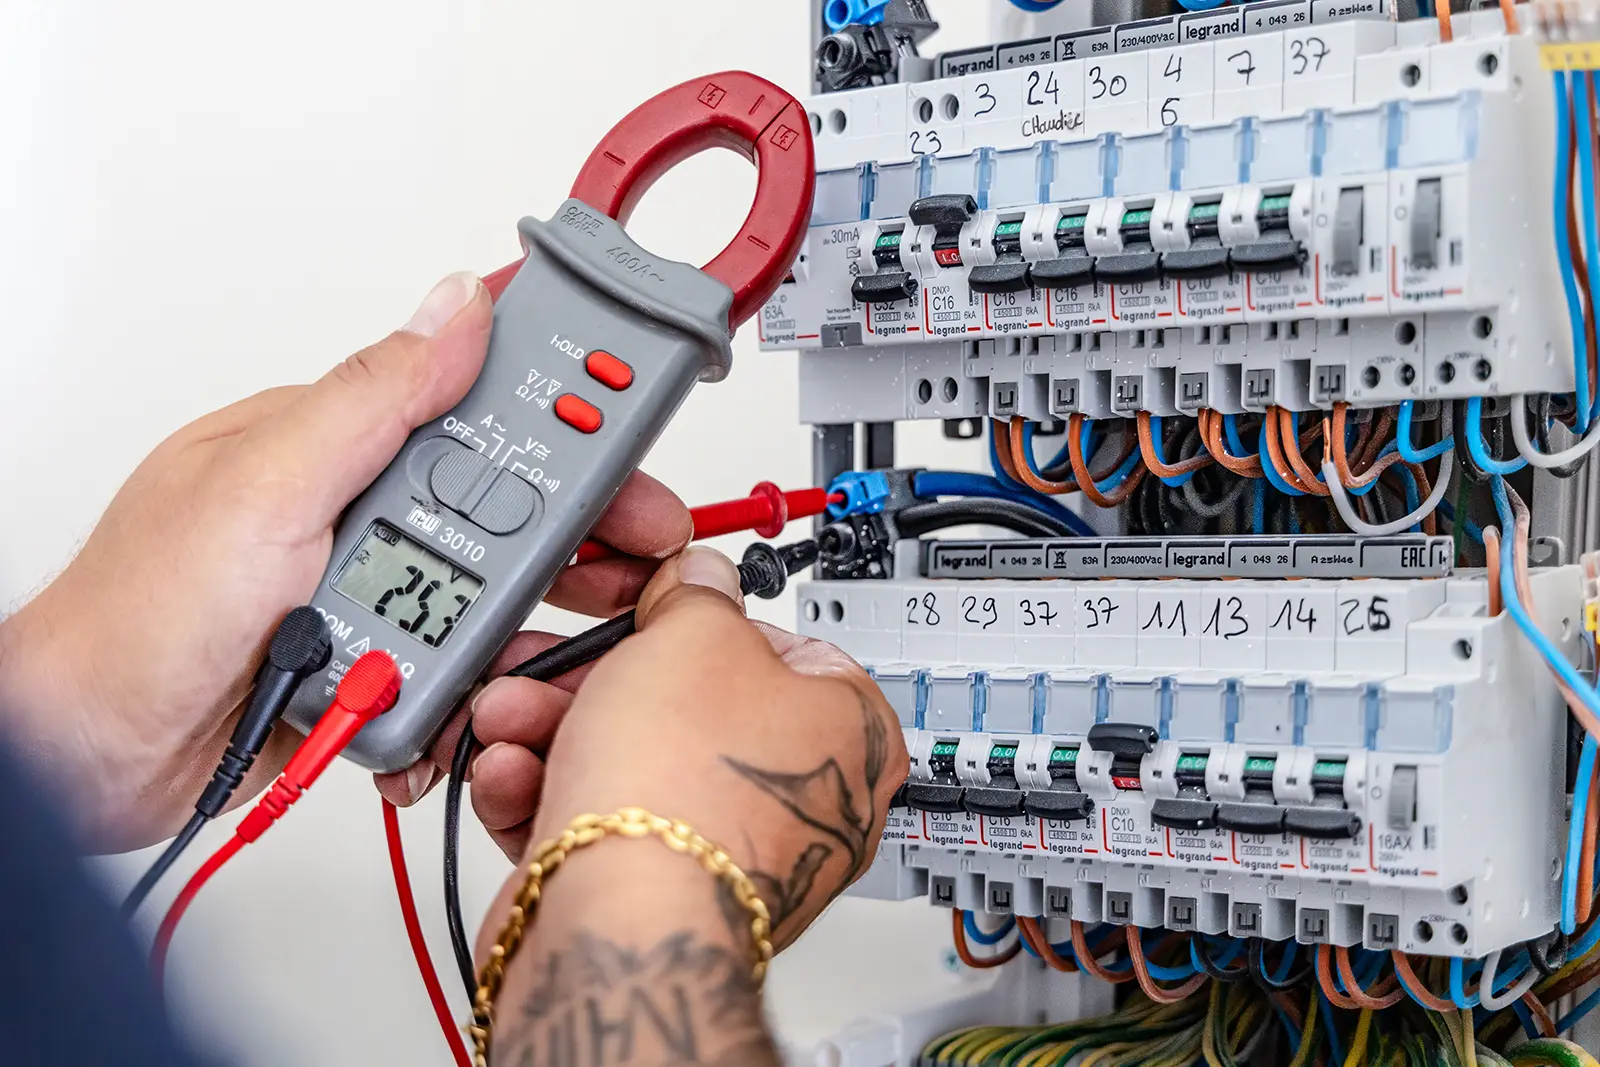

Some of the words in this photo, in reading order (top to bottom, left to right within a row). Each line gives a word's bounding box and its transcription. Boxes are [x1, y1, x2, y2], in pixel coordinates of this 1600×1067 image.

[1256, 18, 1262, 27] 4
[1294, 12, 1305, 22] 26
[1186, 19, 1239, 40] legrand
[1121, 31, 1175, 48] 230/400Vac
[1092, 42, 1109, 52] 63A
[1008, 56, 1014, 65] 4
[1040, 50, 1051, 60] 26
[1290, 37, 1330, 74] 37
[947, 57, 994, 76] legrand
[1164, 53, 1182, 83] 4
[1227, 50, 1256, 85] 7
[1027, 70, 1060, 106] 24
[1089, 66, 1127, 99] 30
[974, 83, 997, 117] 3
[1161, 97, 1180, 126] 6
[909, 130, 942, 155] 23
[831, 227, 860, 244] 30mA
[993, 292, 1016, 306] C16
[1054, 288, 1078, 303] C16
[1154, 295, 1167, 304] 6kA
[1325, 294, 1365, 307] legrand
[932, 295, 954, 311] C16
[1088, 303, 1101, 312] 6kA
[1256, 300, 1295, 313] legrand
[904, 312, 916, 321] 6kA
[964, 310, 976, 320] 6kA
[1026, 306, 1038, 315] 6kA
[1120, 310, 1156, 323] legrand
[1187, 306, 1224, 319] legrand
[875, 325, 906, 336] legrand
[934, 324, 966, 336] legrand
[1055, 317, 1090, 330] legrand
[766, 332, 796, 344] legrand
[550, 334, 586, 361] HOLD
[443, 416, 476, 439] OFF
[375, 528, 399, 545] AUTO
[439, 527, 486, 562] 3010
[941, 554, 987, 569] legrand
[1000, 556, 1006, 565] 4
[1032, 556, 1042, 565] 26
[1082, 556, 1099, 565] 63A
[1111, 555, 1163, 565] 230/400Vac
[1173, 552, 1225, 567] legrand
[1240, 555, 1247, 564] 4
[1277, 555, 1289, 564] 26
[1401, 547, 1426, 567] EAC
[450, 565, 464, 584] V
[906, 592, 941, 626] 28
[962, 595, 998, 629] 29
[1020, 599, 1058, 626] 37
[1084, 596, 1119, 628] 37
[1269, 597, 1317, 633] 14
[1142, 599, 1187, 637] 11
[1203, 596, 1249, 640] 13
[903, 819, 915, 828] 6kA
[961, 824, 974, 833] 6kA
[1111, 817, 1135, 832] C10
[883, 831, 905, 840] grand
[932, 835, 964, 846] legrand
[1020, 830, 1033, 838] 6kA
[1081, 833, 1093, 841] 6kA
[1145, 835, 1158, 844] 6kA
[990, 839, 1023, 851] legrand
[1049, 843, 1083, 855] legrand
[1209, 840, 1223, 849] 6kA
[1112, 845, 1147, 859] legrand
[1176, 850, 1212, 863] legrand
[1241, 858, 1278, 870] legrand
[1310, 860, 1348, 872] legrand
[1378, 864, 1419, 877] legrand
[1405, 942, 1414, 951] A1
